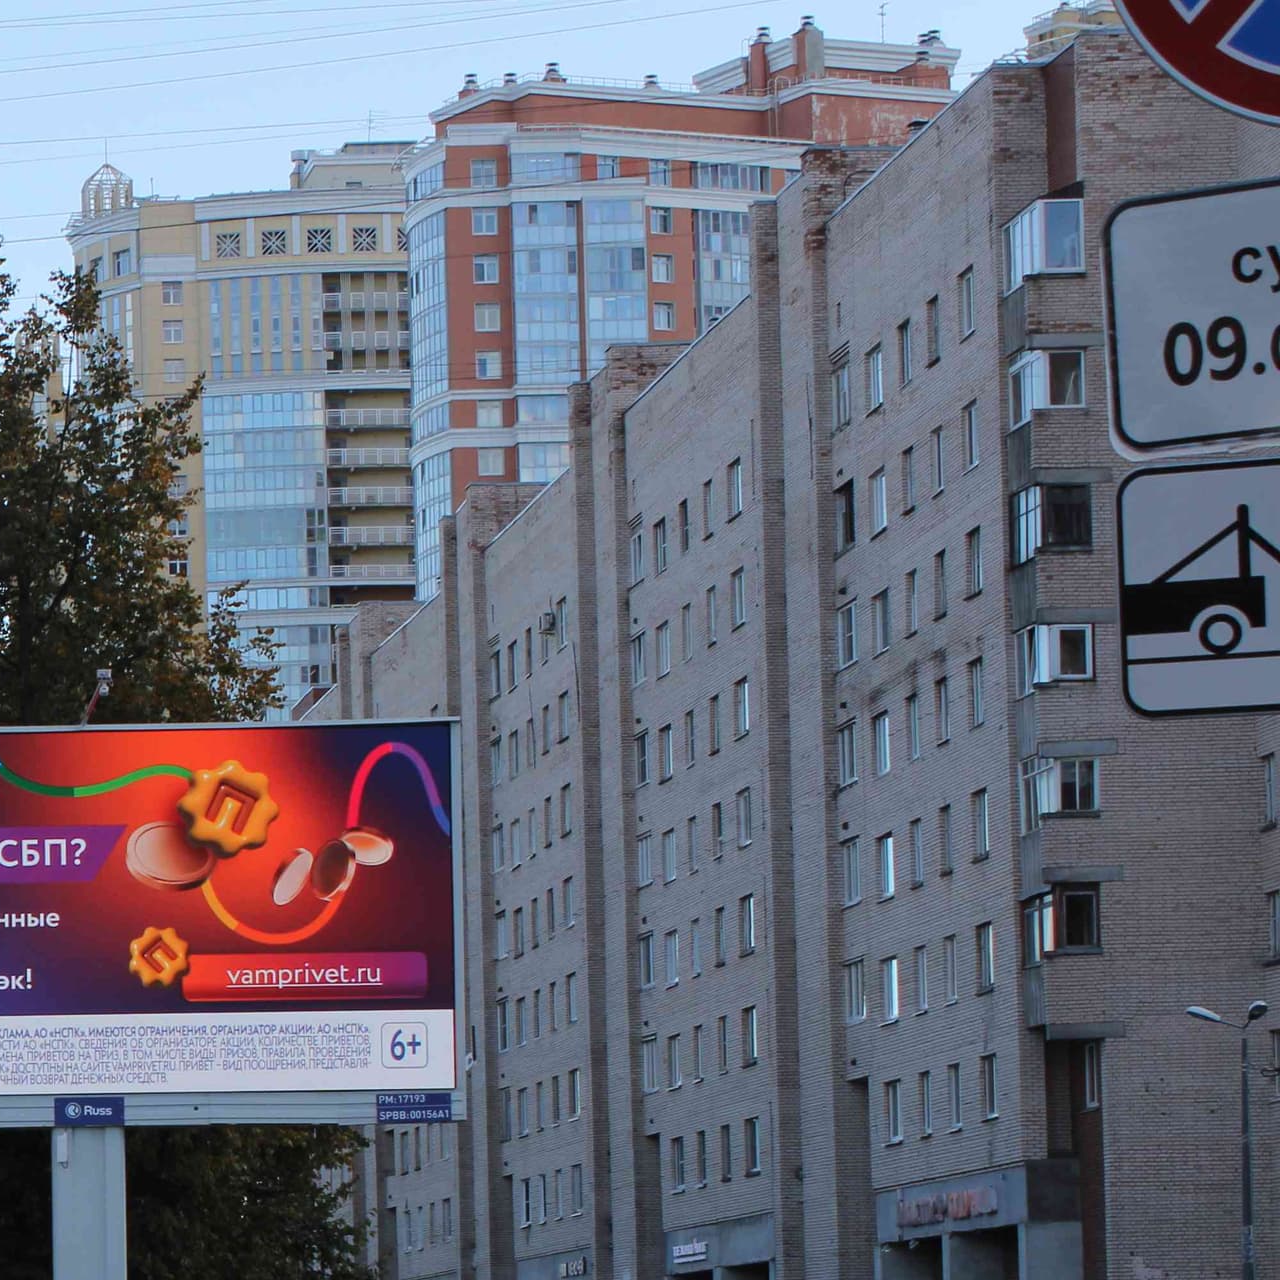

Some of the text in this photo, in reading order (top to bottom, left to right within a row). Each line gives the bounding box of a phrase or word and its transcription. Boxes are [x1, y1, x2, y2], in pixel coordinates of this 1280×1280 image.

[1163, 315, 1280, 387] 09.
[226, 963, 382, 989] vamprivet.ru
[34, 1028, 47, 1038] АО
[90, 1026, 136, 1037] ИМЕЮТСЯ
[210, 1024, 276, 1035] ОРГАНИЗАТОР
[279, 1024, 315, 1034] АКЦИИ:
[318, 1024, 331, 1034] АО
[23, 1039, 36, 1050] АО
[78, 1038, 126, 1049] СВЕДЕНИЯ
[130, 1038, 142, 1048] ОБ
[146, 1037, 216, 1048] ОРГАНИЗАТОРЕ
[258, 1035, 318, 1046] КОЛИЧЕСТВЕ
[390, 1029, 421, 1061] 6+
[26, 1050, 74, 1061] ПРИВЕТОВ
[78, 1050, 90, 1060] НА
[123, 1049, 128, 1060] В
[131, 1049, 152, 1060] ТОМ
[155, 1048, 186, 1059] ЧИСЛЕ
[189, 1048, 215, 1059] ВИДЫ
[261, 1047, 304, 1058] ПРАВИЛА
[308, 1046, 370, 1057] ПРОВЕДЕНИЯ
[10, 1062, 63, 1073] ДОСТУПНЫ
[66, 1062, 78, 1072] НА
[178, 1060, 213, 1071] ПРИВЕТ
[223, 1060, 243, 1070] ВИД
[30, 1074, 69, 1085] ВОЗВРАТ
[71, 1073, 124, 1084] ДЕНЕЖНЫХ
[83, 1105, 113, 1116] Russ
[379, 1109, 449, 1120] SPBB:00156A1
